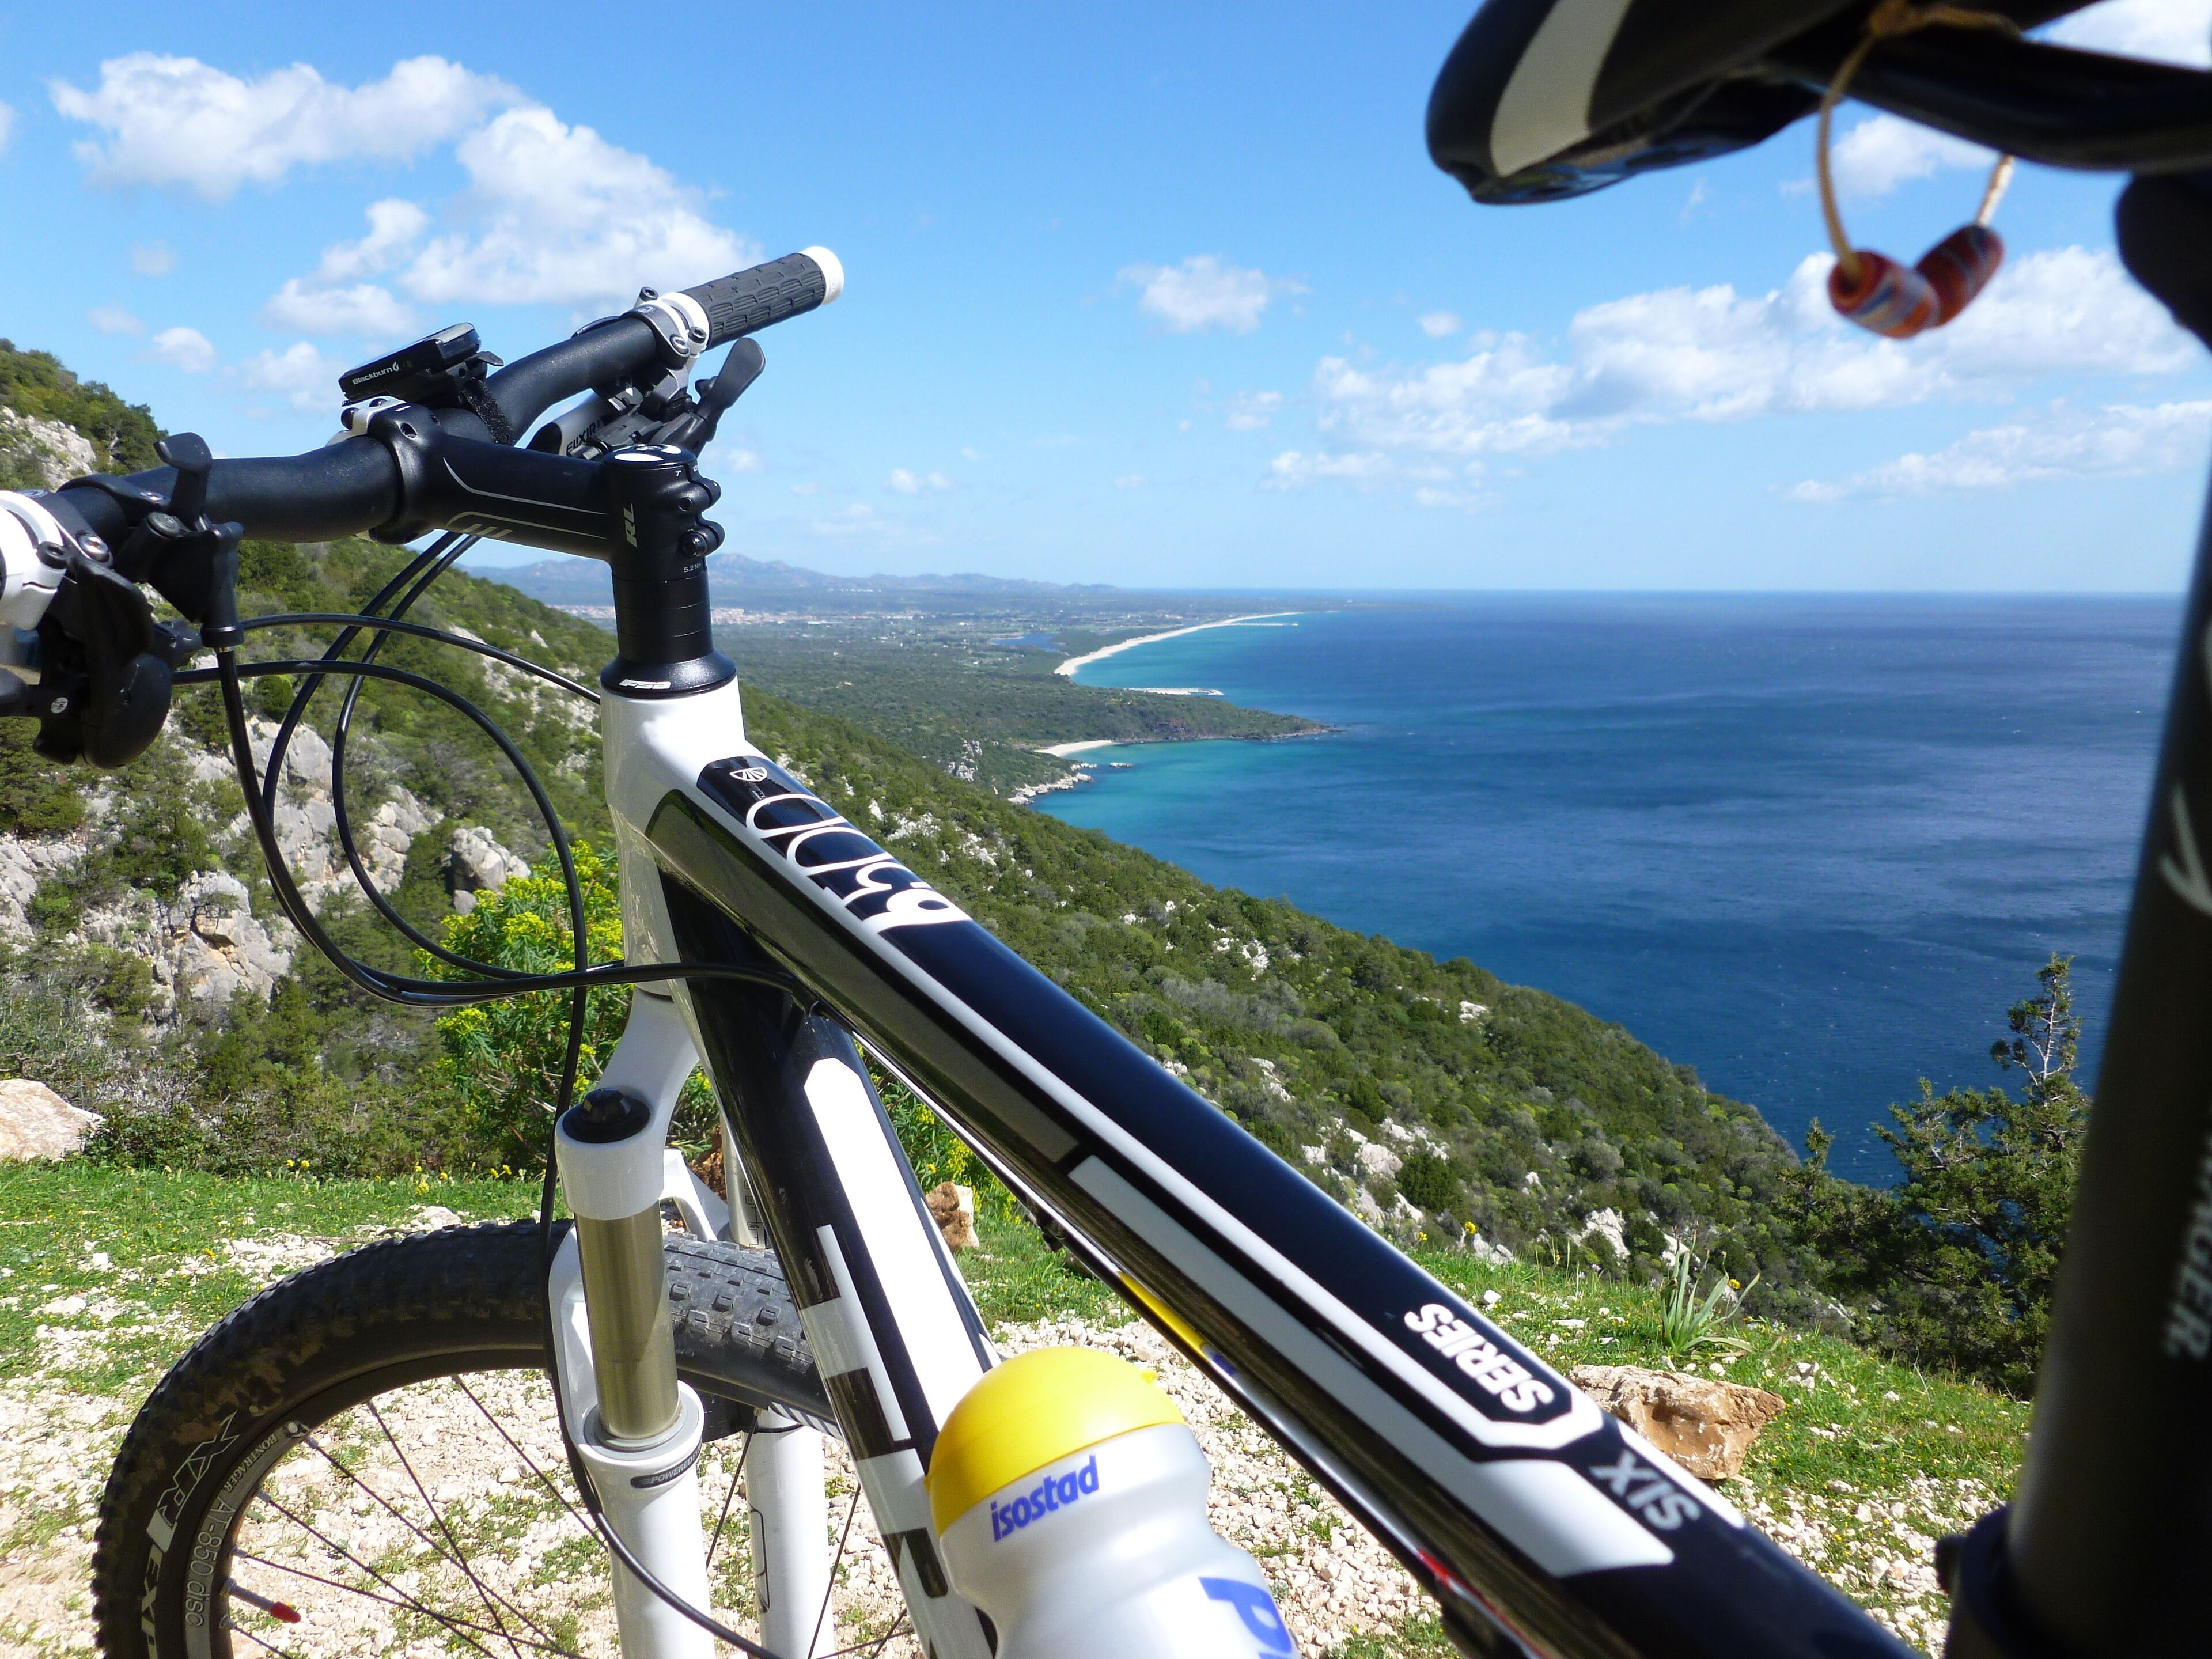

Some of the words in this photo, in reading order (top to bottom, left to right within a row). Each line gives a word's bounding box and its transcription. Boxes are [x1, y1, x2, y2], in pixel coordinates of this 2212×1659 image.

[352, 367, 393, 385] Blackburn
[1404, 1303, 1555, 1412] SERIES
[224, 1433, 278, 1493] BONTRAGER
[650, 1455, 691, 1484] POWERED
[1588, 1449, 1702, 1531] SIX
[990, 1454, 1100, 1543] isostad
[190, 1496, 237, 1576] AT-850
[185, 1580, 211, 1627] disc
